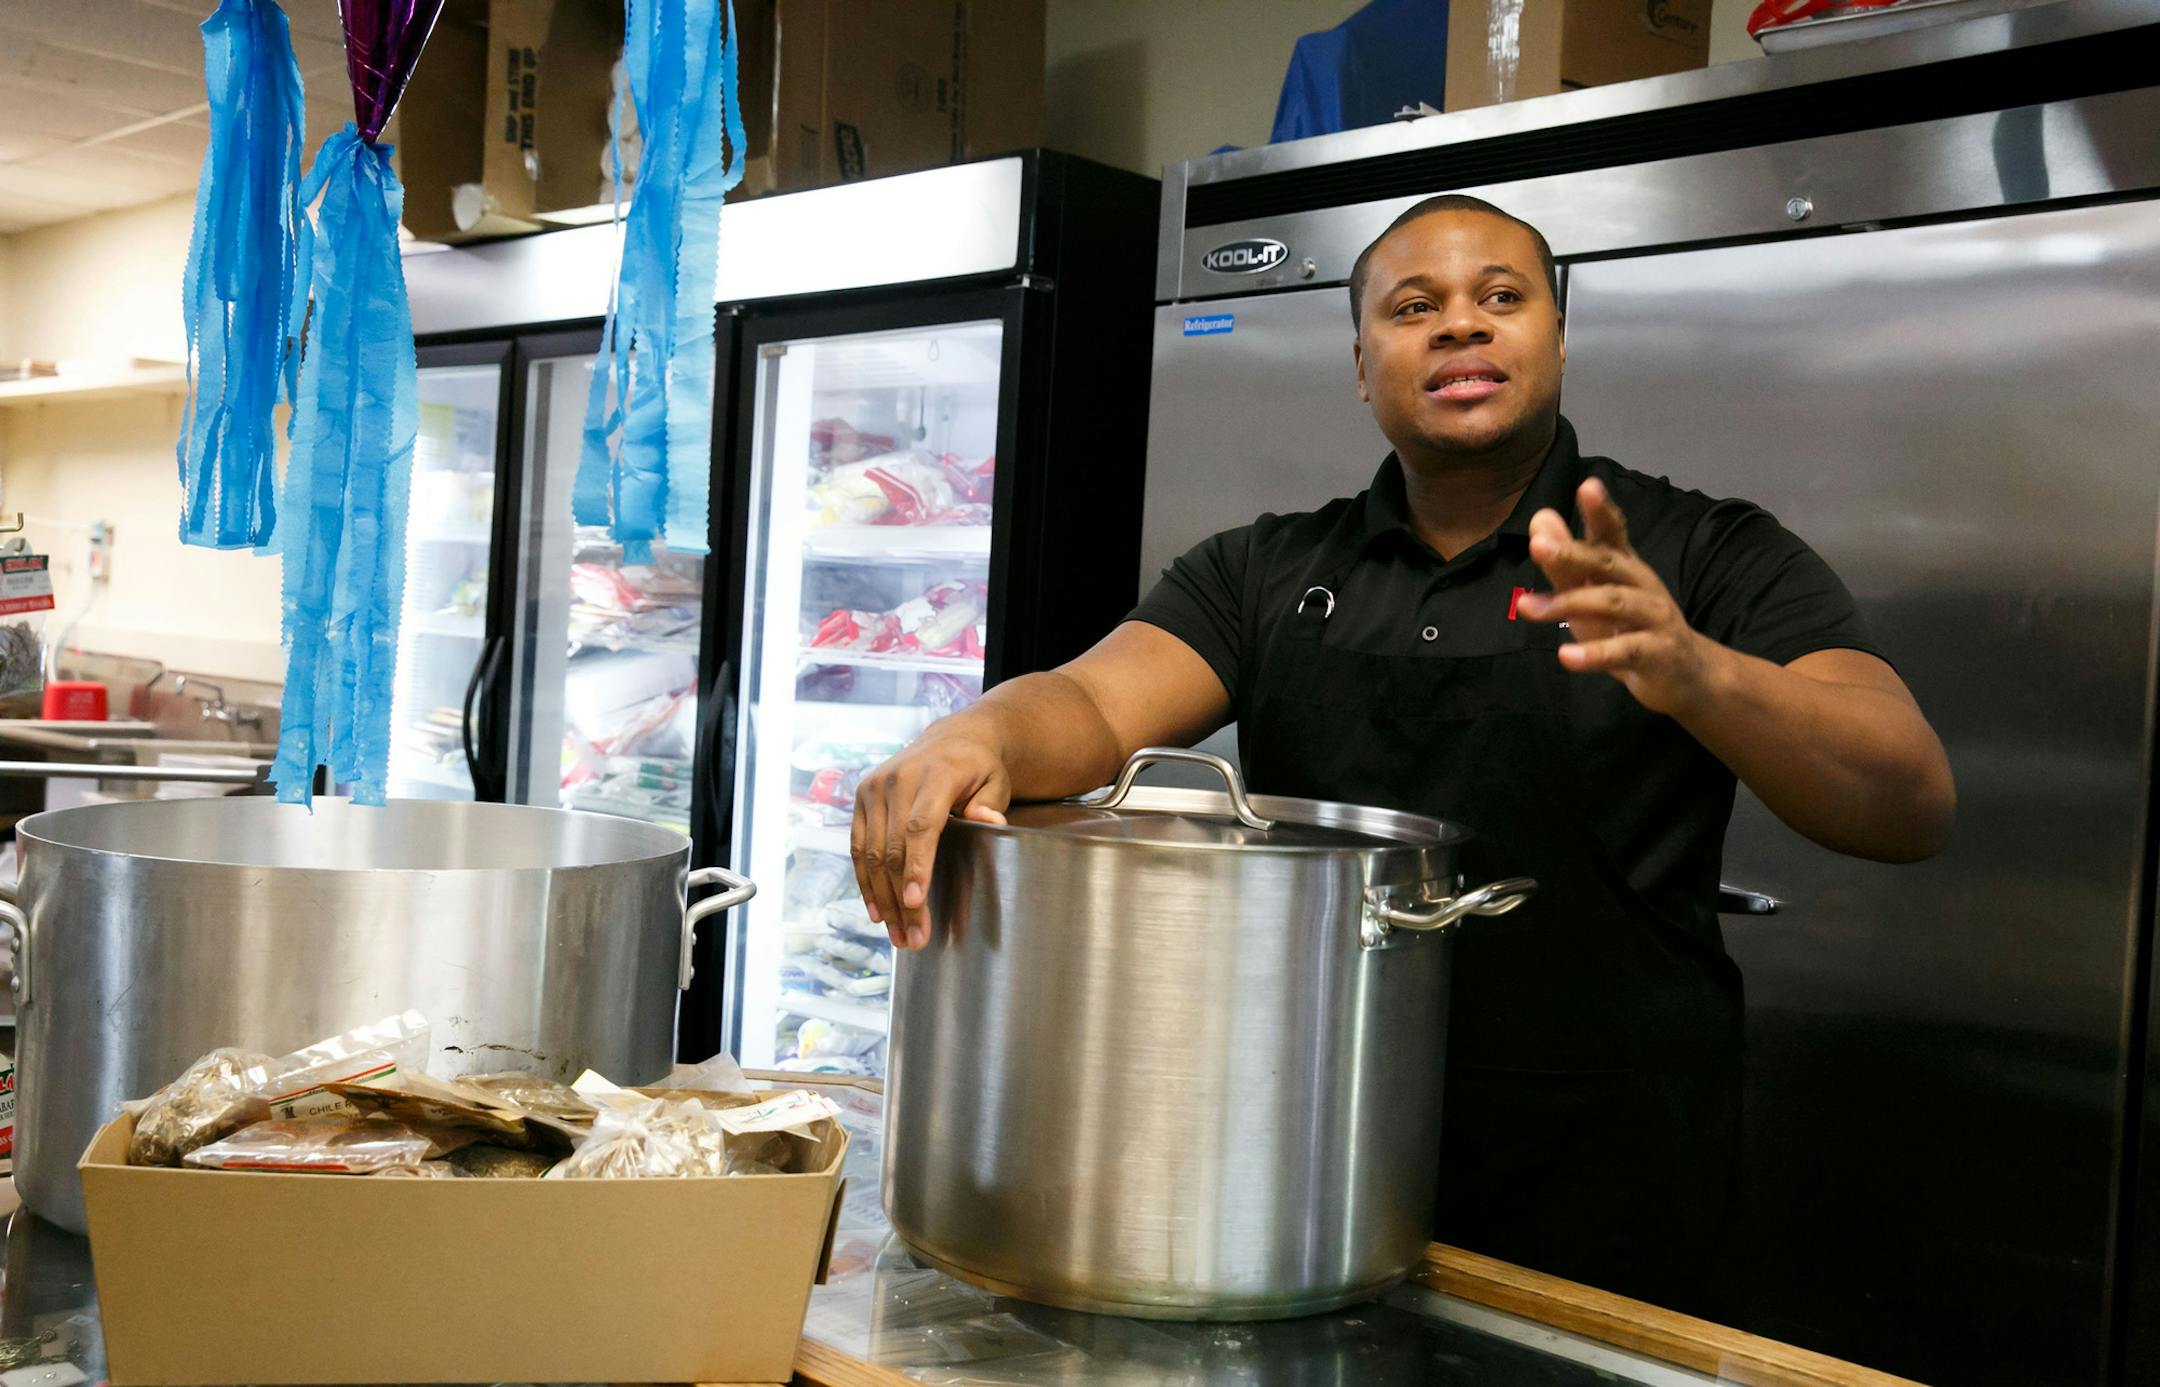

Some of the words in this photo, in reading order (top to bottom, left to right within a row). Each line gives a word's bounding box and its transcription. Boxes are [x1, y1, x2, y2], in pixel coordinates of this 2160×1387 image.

[521, 73, 535, 108] END
[1184, 319, 1233, 332] Refrigerator
[309, 1101, 342, 1116] CHILE
